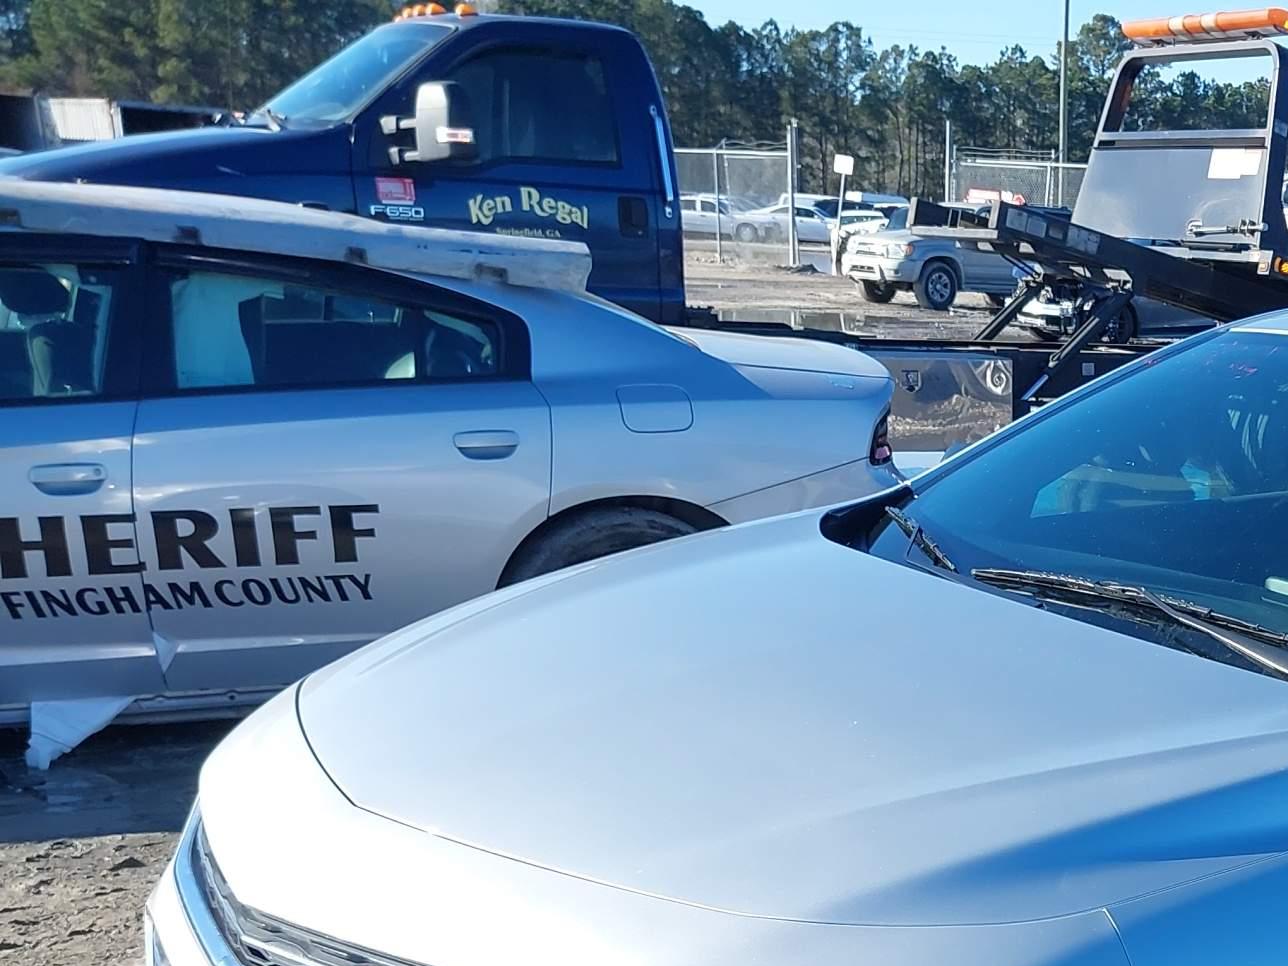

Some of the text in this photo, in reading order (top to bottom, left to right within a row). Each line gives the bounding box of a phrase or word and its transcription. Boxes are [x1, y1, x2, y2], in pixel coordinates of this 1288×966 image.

[468, 186, 588, 229] Ken Regal
[214, 574, 374, 607] COUNTY
